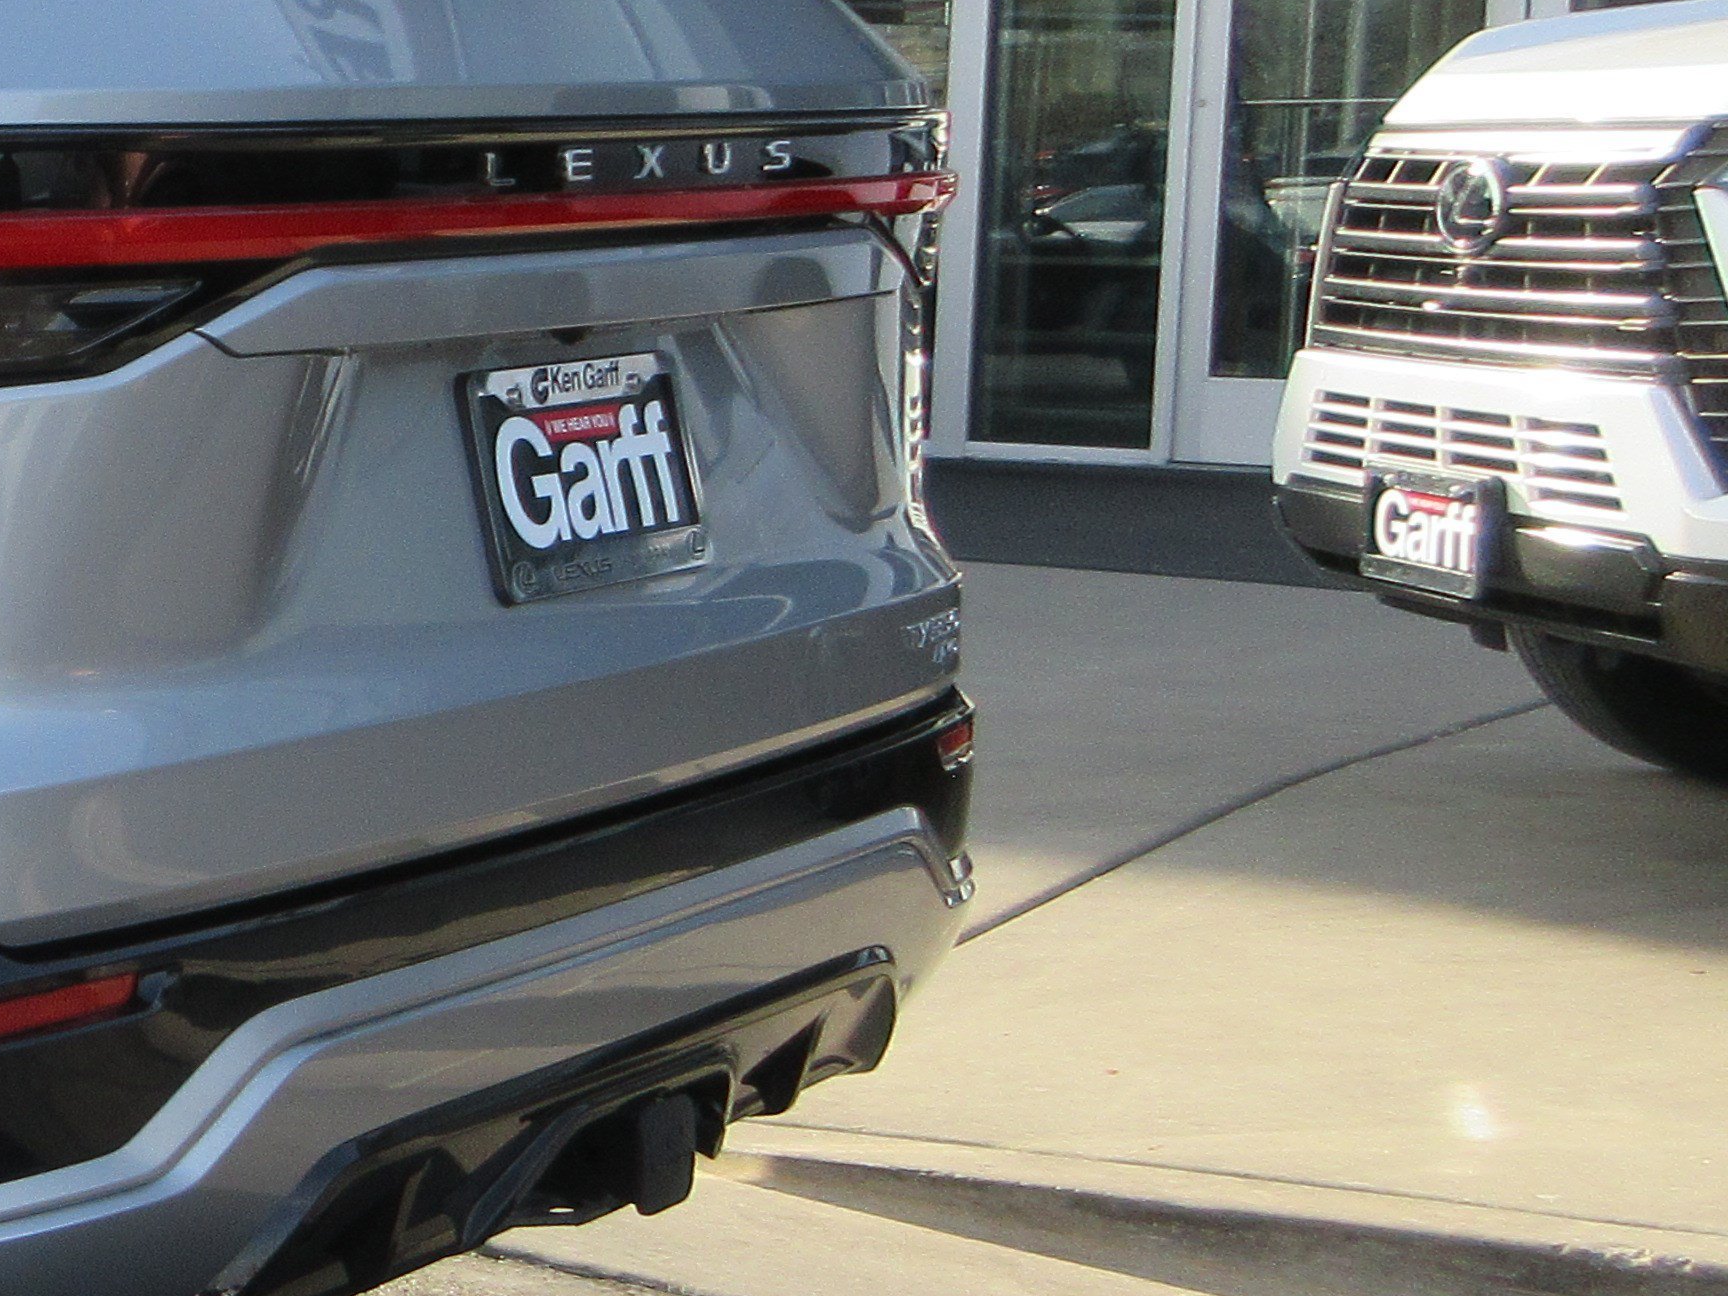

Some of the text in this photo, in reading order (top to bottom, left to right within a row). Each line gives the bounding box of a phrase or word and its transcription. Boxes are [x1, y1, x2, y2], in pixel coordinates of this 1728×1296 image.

[485, 140, 792, 187] LEXUS
[549, 360, 620, 394] Ken Garff
[495, 400, 680, 549] Garff
[1375, 488, 1478, 571] Garff
